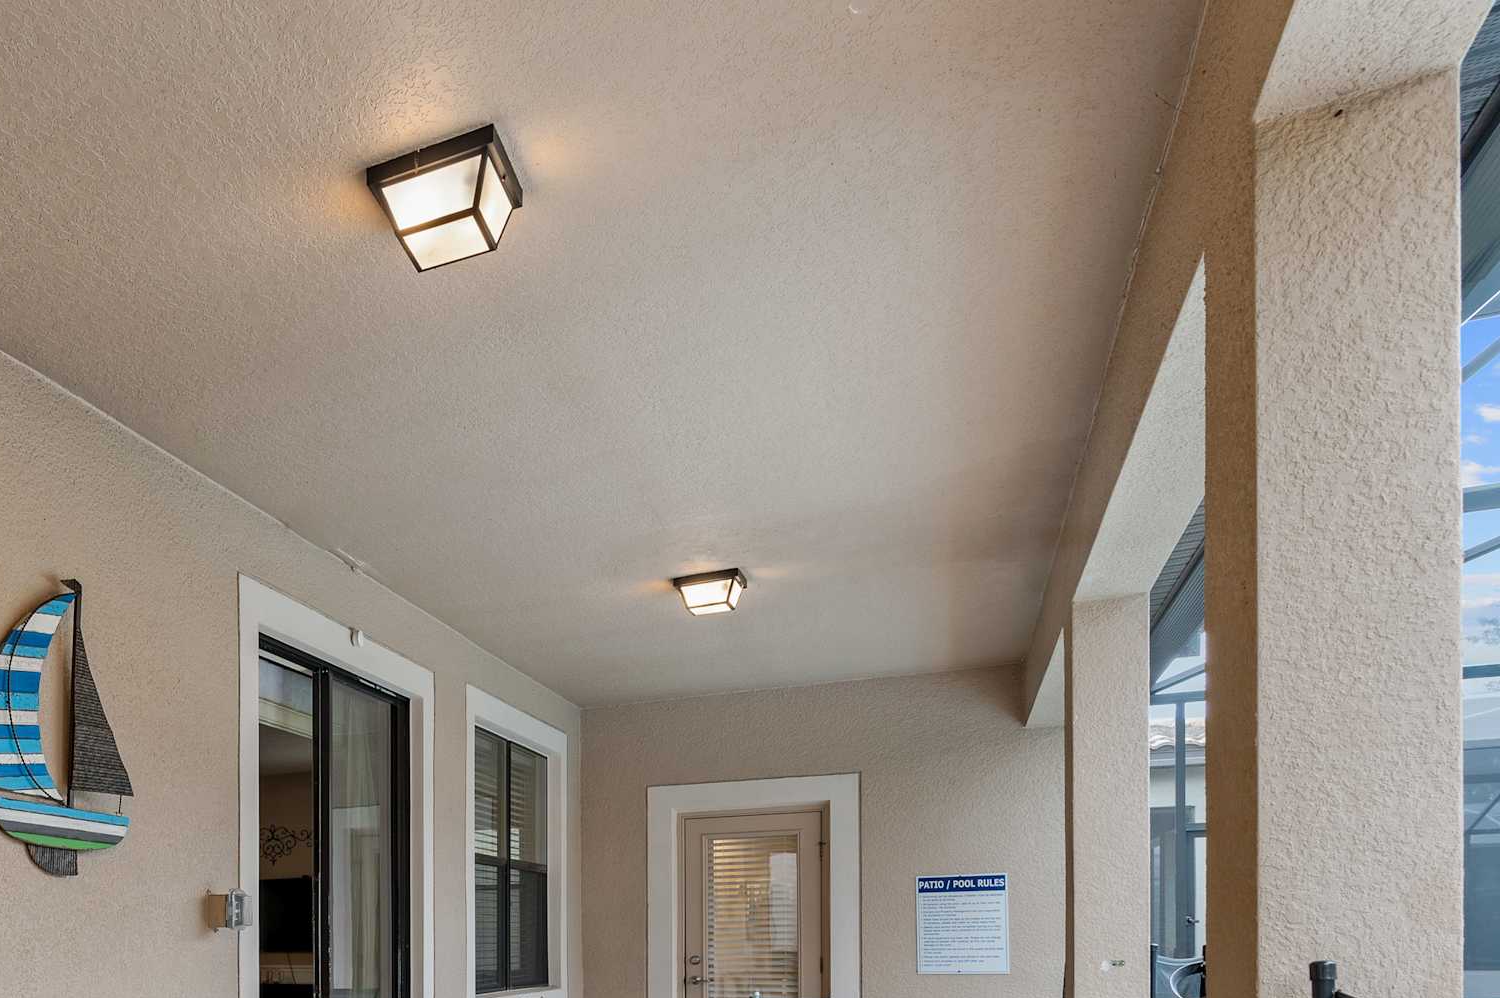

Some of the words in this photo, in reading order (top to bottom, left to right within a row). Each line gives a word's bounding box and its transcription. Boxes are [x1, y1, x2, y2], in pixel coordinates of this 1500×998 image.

[919, 880, 945, 889] PATIO
[953, 879, 975, 888] POOL
[978, 878, 1005, 887] RULES
